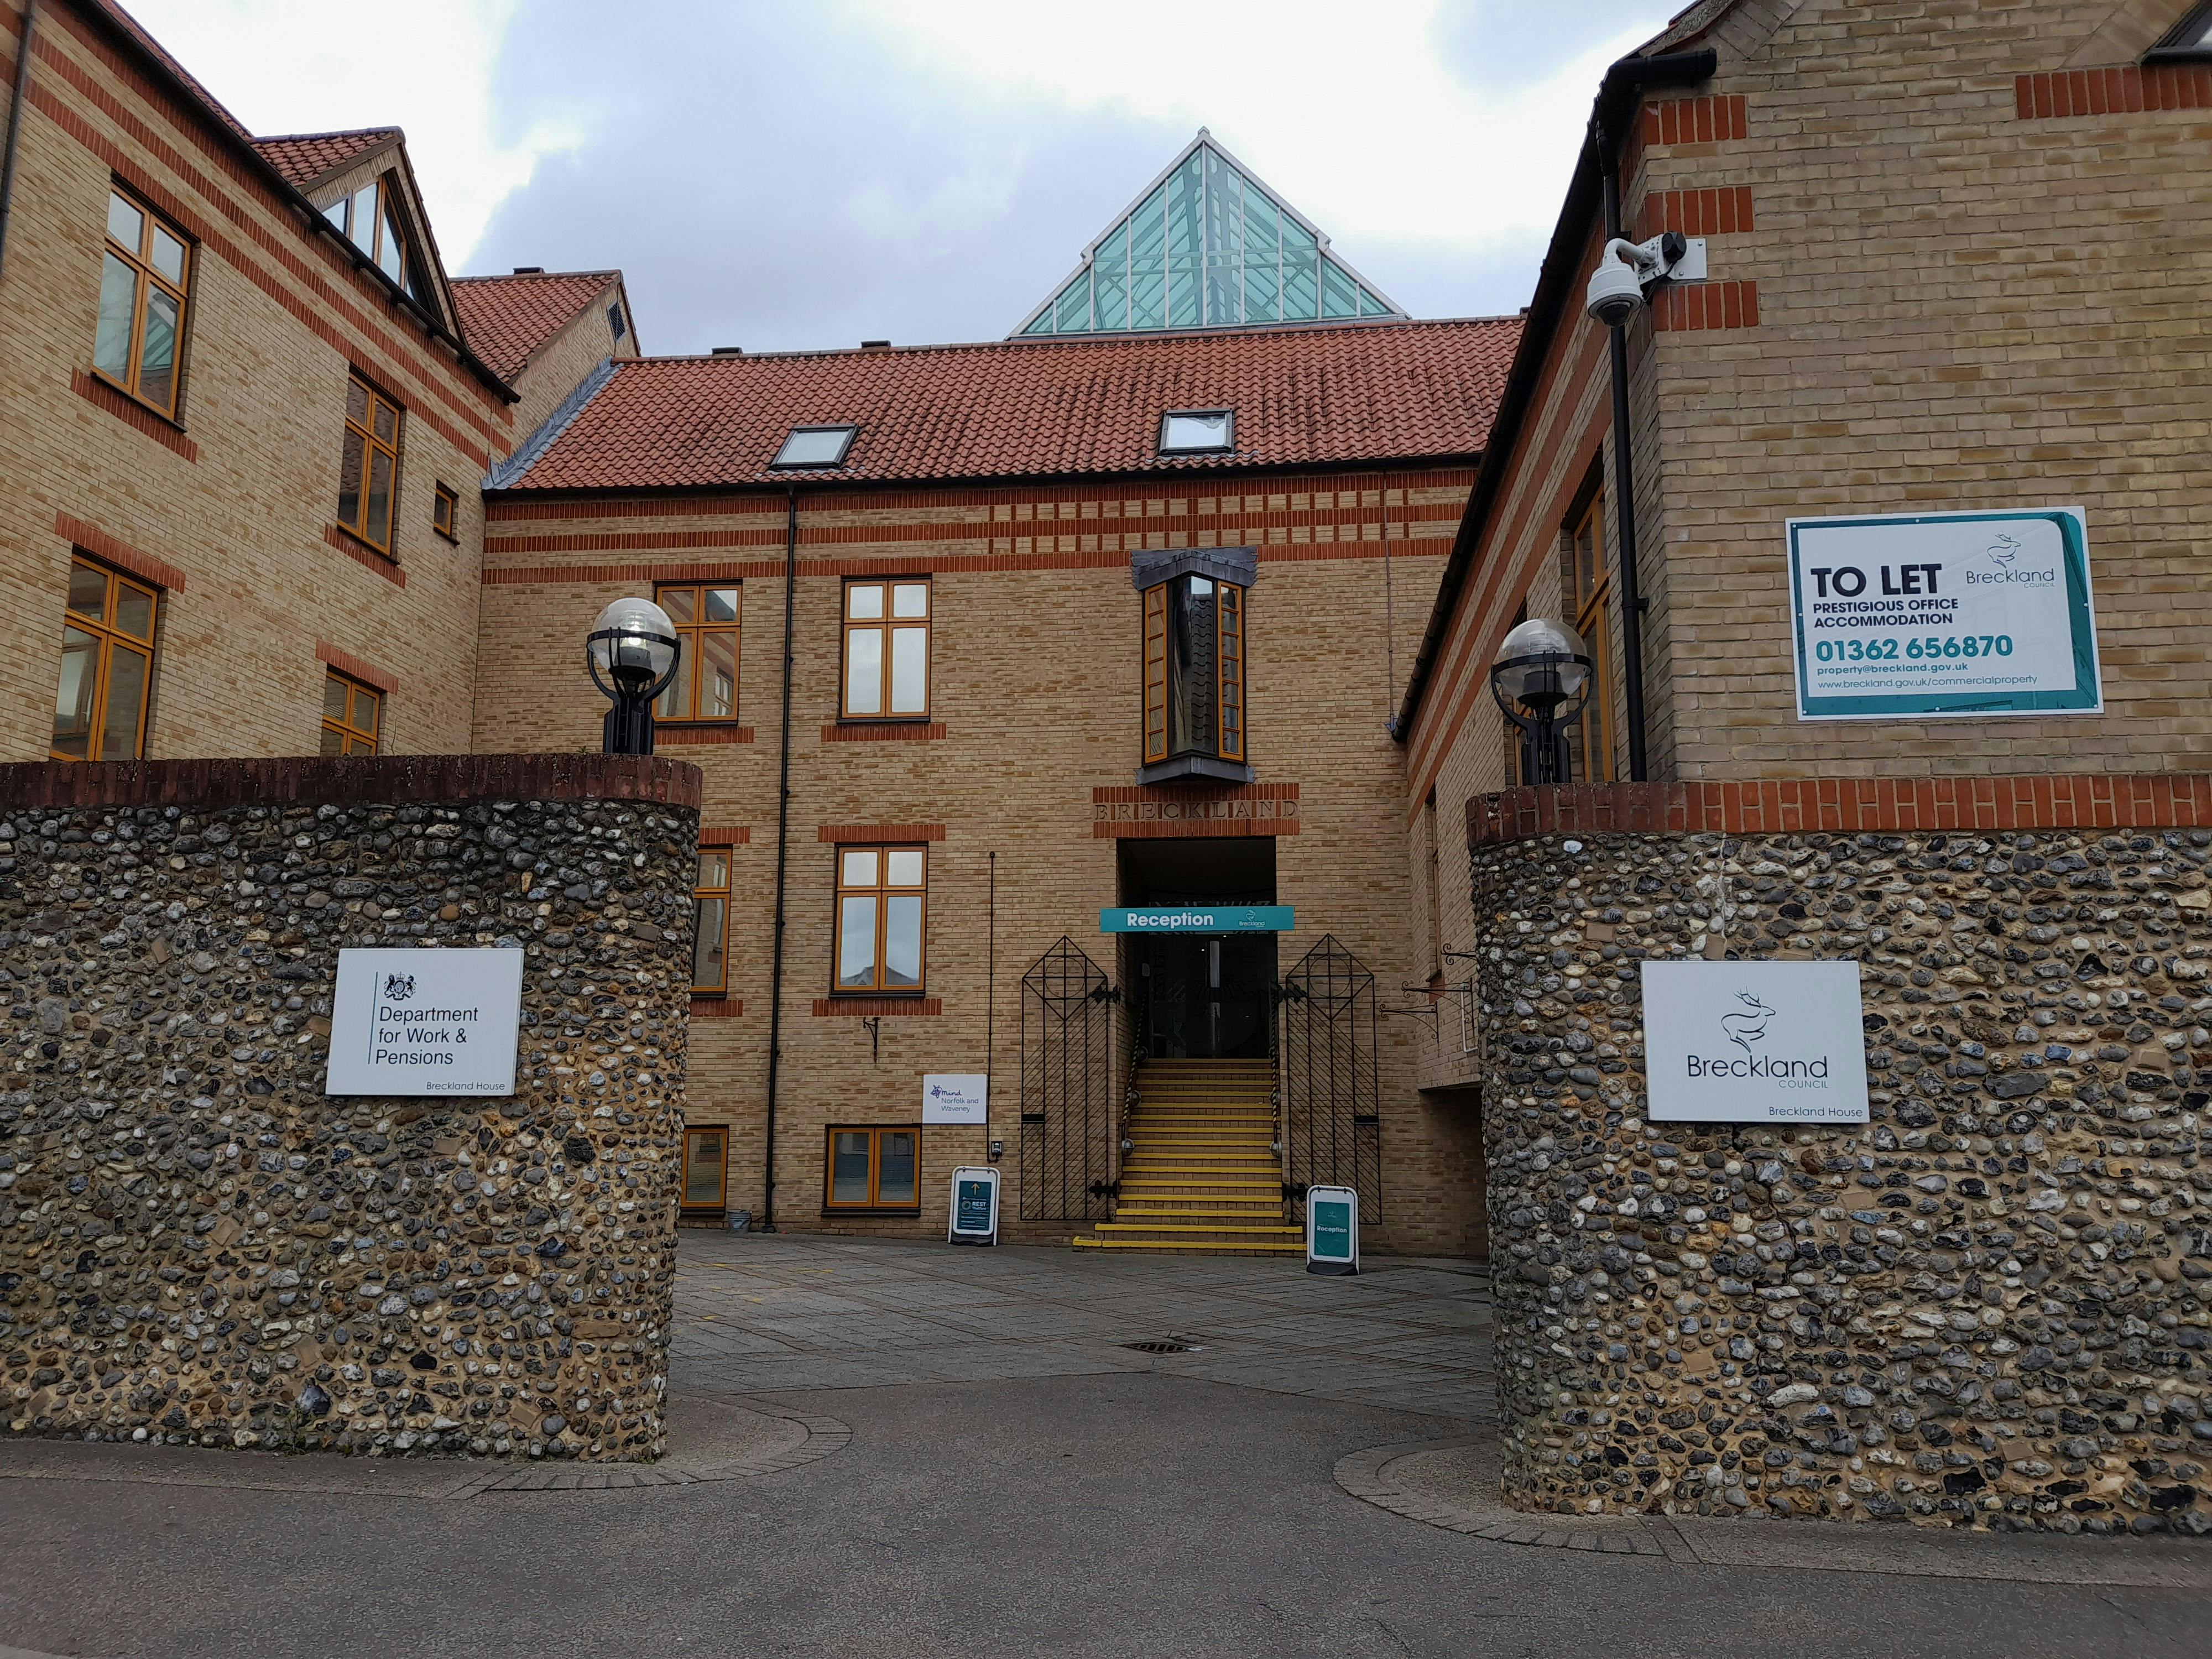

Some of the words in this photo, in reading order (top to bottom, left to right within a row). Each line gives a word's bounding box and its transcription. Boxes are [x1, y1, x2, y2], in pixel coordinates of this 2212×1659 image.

[1810, 566, 1867, 597] TO
[1881, 564, 1942, 596] LET
[1966, 568, 2054, 585] Breckland
[1813, 600, 1905, 614] PRESTIGIOUS
[1908, 598, 1959, 611] OFFICE
[1814, 613, 1953, 628] ACCOMMODATION
[1816, 638, 1900, 661] 01362
[1906, 634, 2013, 658] 656870
[1817, 662, 1968, 676] property@breckland.gov.uk
[1818, 675, 2037, 688] www.breckland.gov.uk/commercialproperty
[1094, 801, 1298, 820] BRECKLAND
[1126, 912, 1214, 929] Reception
[379, 1006, 478, 1025] Department
[379, 1028, 401, 1044] for
[407, 1028, 450, 1044] Work
[456, 1028, 467, 1044] &
[375, 1049, 453, 1065] Pensions
[1687, 1055, 1828, 1078] Breckland
[426, 1081, 473, 1091] Breckland
[476, 1081, 505, 1091] House
[1778, 1079, 1829, 1089] COUNCIL
[1768, 1106, 1825, 1117] Breckland
[1828, 1107, 1863, 1117] House
